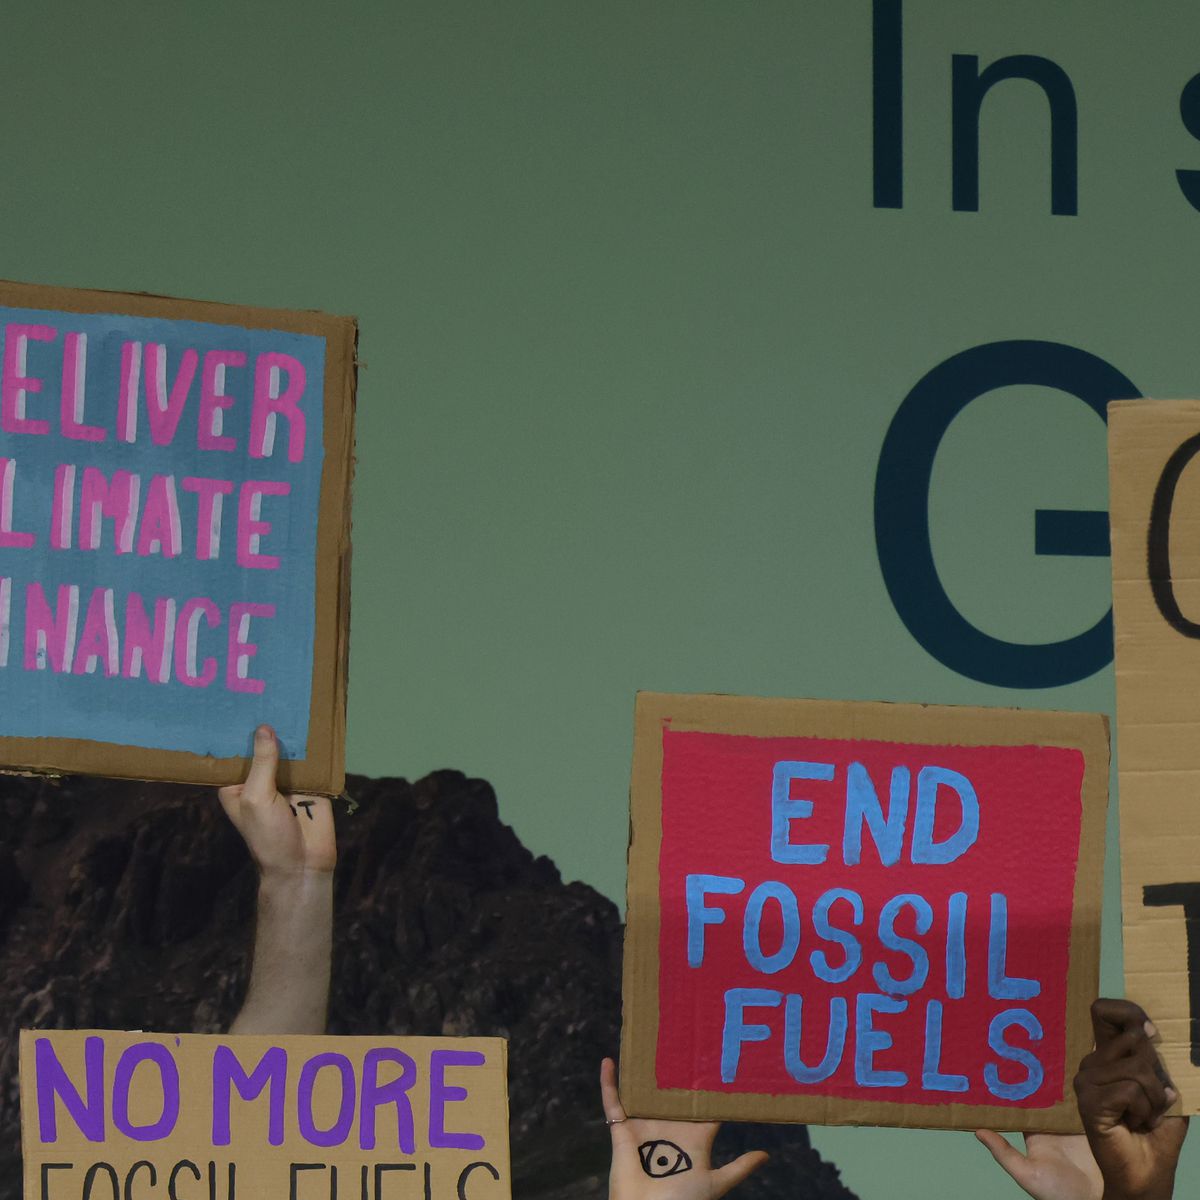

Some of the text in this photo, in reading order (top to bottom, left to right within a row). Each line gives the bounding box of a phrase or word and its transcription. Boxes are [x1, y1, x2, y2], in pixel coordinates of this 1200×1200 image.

[872, 0, 1078, 216] In
[2, 323, 307, 463] ELIVER
[771, 760, 980, 867] END
[686, 873, 1041, 1000] FOSSIL
[35, 1036, 486, 1154] NO MORE
[721, 988, 1044, 1100] FUELS
